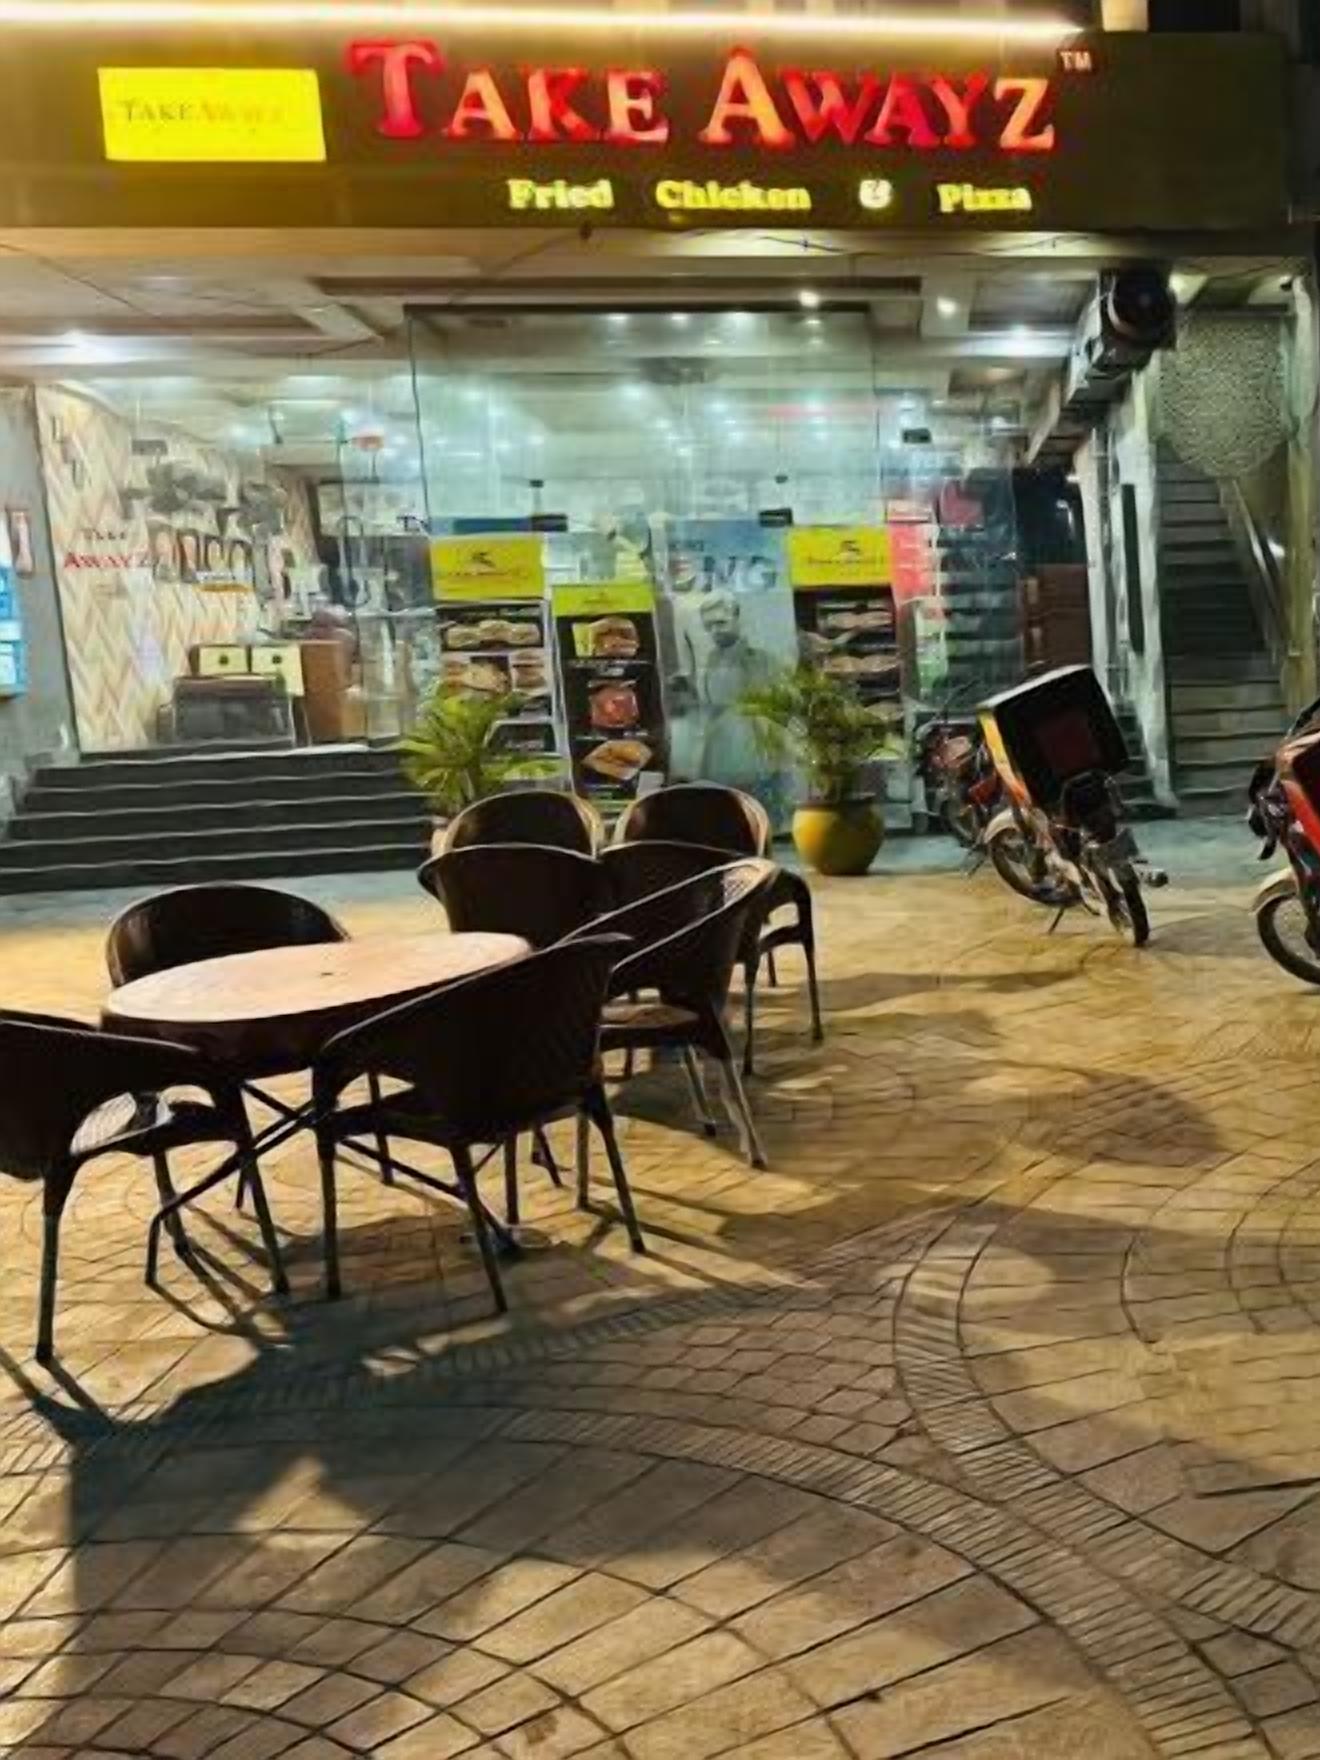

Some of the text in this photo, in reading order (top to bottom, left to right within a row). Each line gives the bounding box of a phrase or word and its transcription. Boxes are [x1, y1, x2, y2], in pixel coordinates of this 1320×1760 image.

[345, 40, 668, 142] TAKE
[699, 46, 1055, 151] AWAYZ
[507, 178, 615, 210] Fried
[655, 179, 812, 211] Chicken
[936, 183, 1033, 213] Pizza
